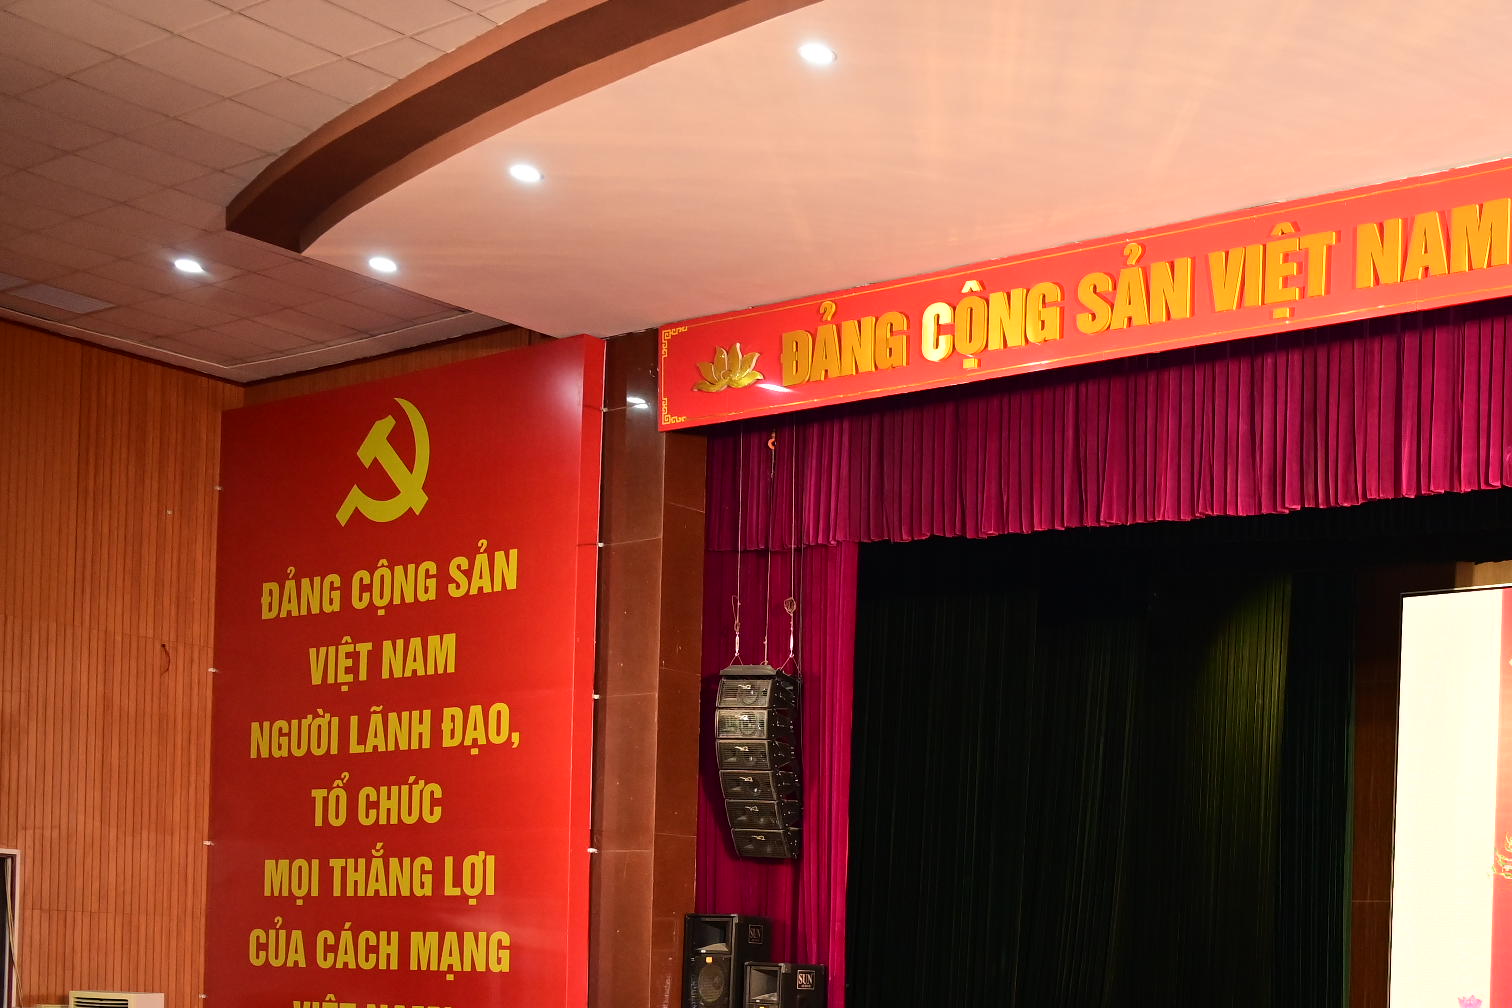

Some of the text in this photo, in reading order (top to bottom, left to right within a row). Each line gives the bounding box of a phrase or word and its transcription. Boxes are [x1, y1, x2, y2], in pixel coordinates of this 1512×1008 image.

[781, 300, 907, 387] ĐẢNG
[920, 280, 1062, 370] CỘNG
[1075, 243, 1191, 335] SẢN
[1208, 222, 1336, 319] VIỆT
[1355, 197, 1512, 289] NAM
[261, 539, 517, 619] ĐẢNG CỘNG SẢN
[309, 633, 456, 691] VIỆT NAM
[251, 703, 519, 758] NGƯỜI LÃNH ĐẠO,
[312, 772, 442, 826] TỔ CHỨC
[265, 843, 495, 905] MỌI THẮNG LỢI
[250, 917, 510, 980] CỦA CÁCH MẠNG
[798, 973, 813, 985] SUN
